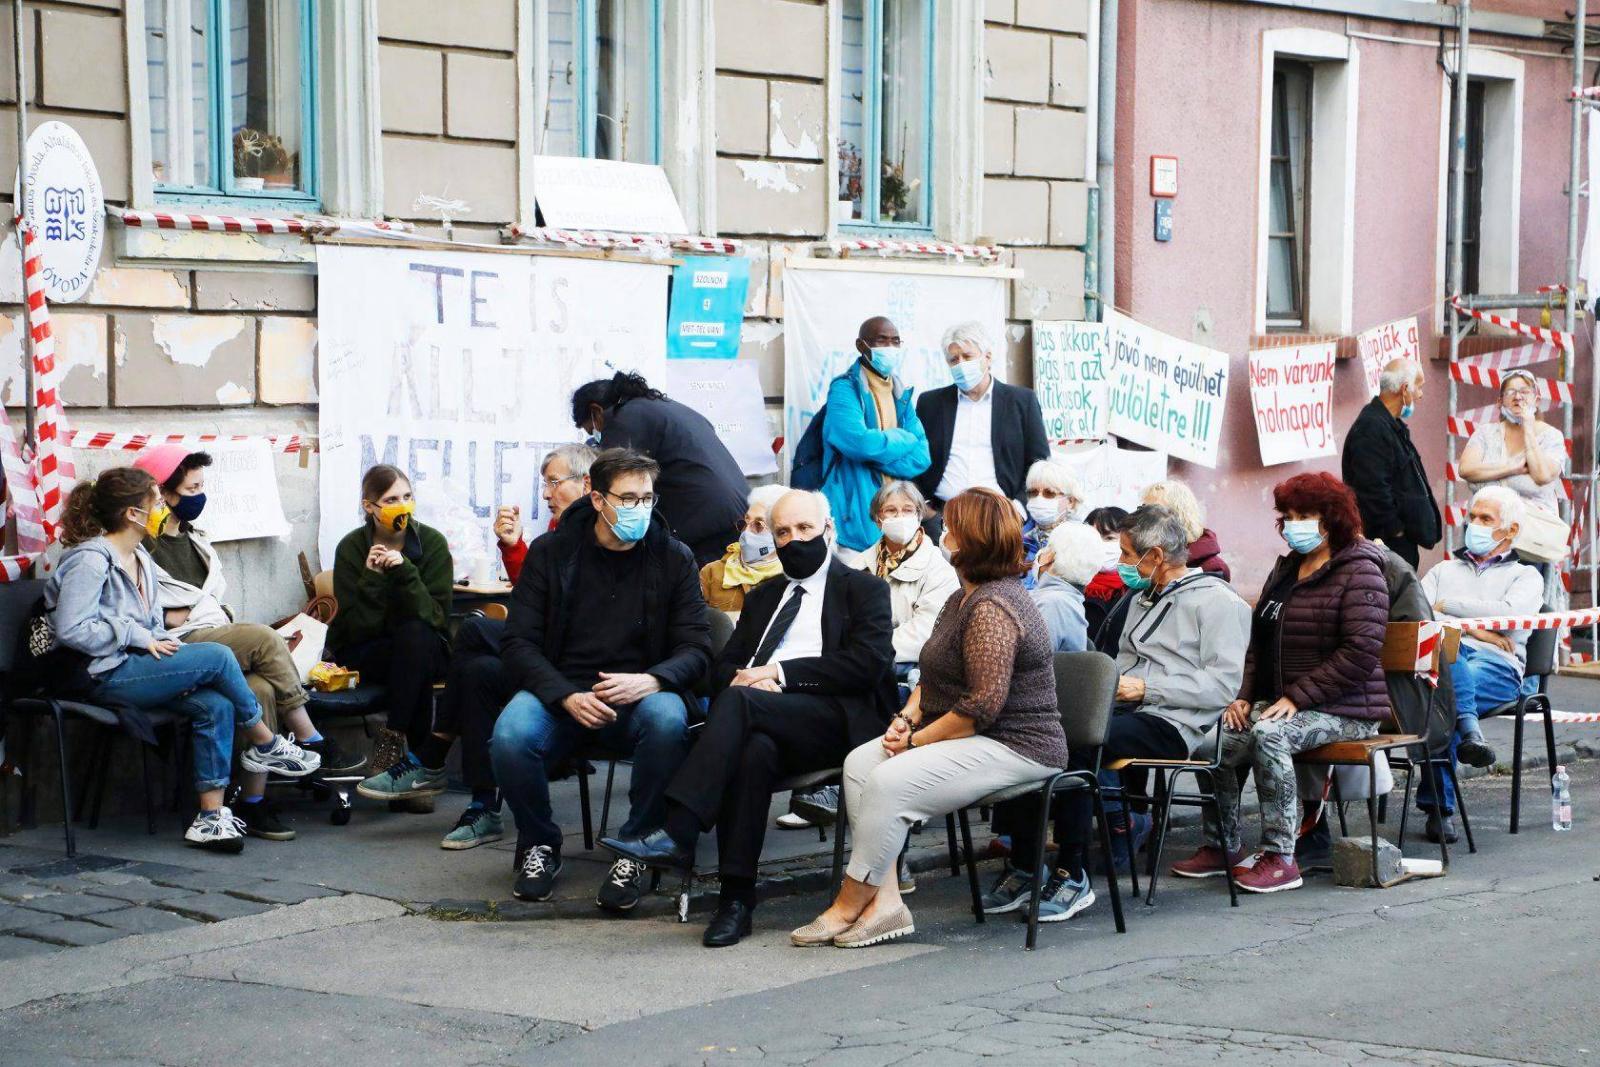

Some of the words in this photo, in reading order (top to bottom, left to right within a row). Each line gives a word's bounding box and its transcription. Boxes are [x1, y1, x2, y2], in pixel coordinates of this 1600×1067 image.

[42, 266, 88, 293] ÓVODA
[408, 262, 499, 328] TE
[1407, 326, 1418, 344] a
[1110, 329, 1141, 370] jövő
[1144, 353, 1168, 378] nem
[1173, 354, 1226, 398] épülhet
[1250, 359, 1279, 388] Nem
[1284, 350, 1335, 385] várunk
[1254, 385, 1333, 449] holnapig!
